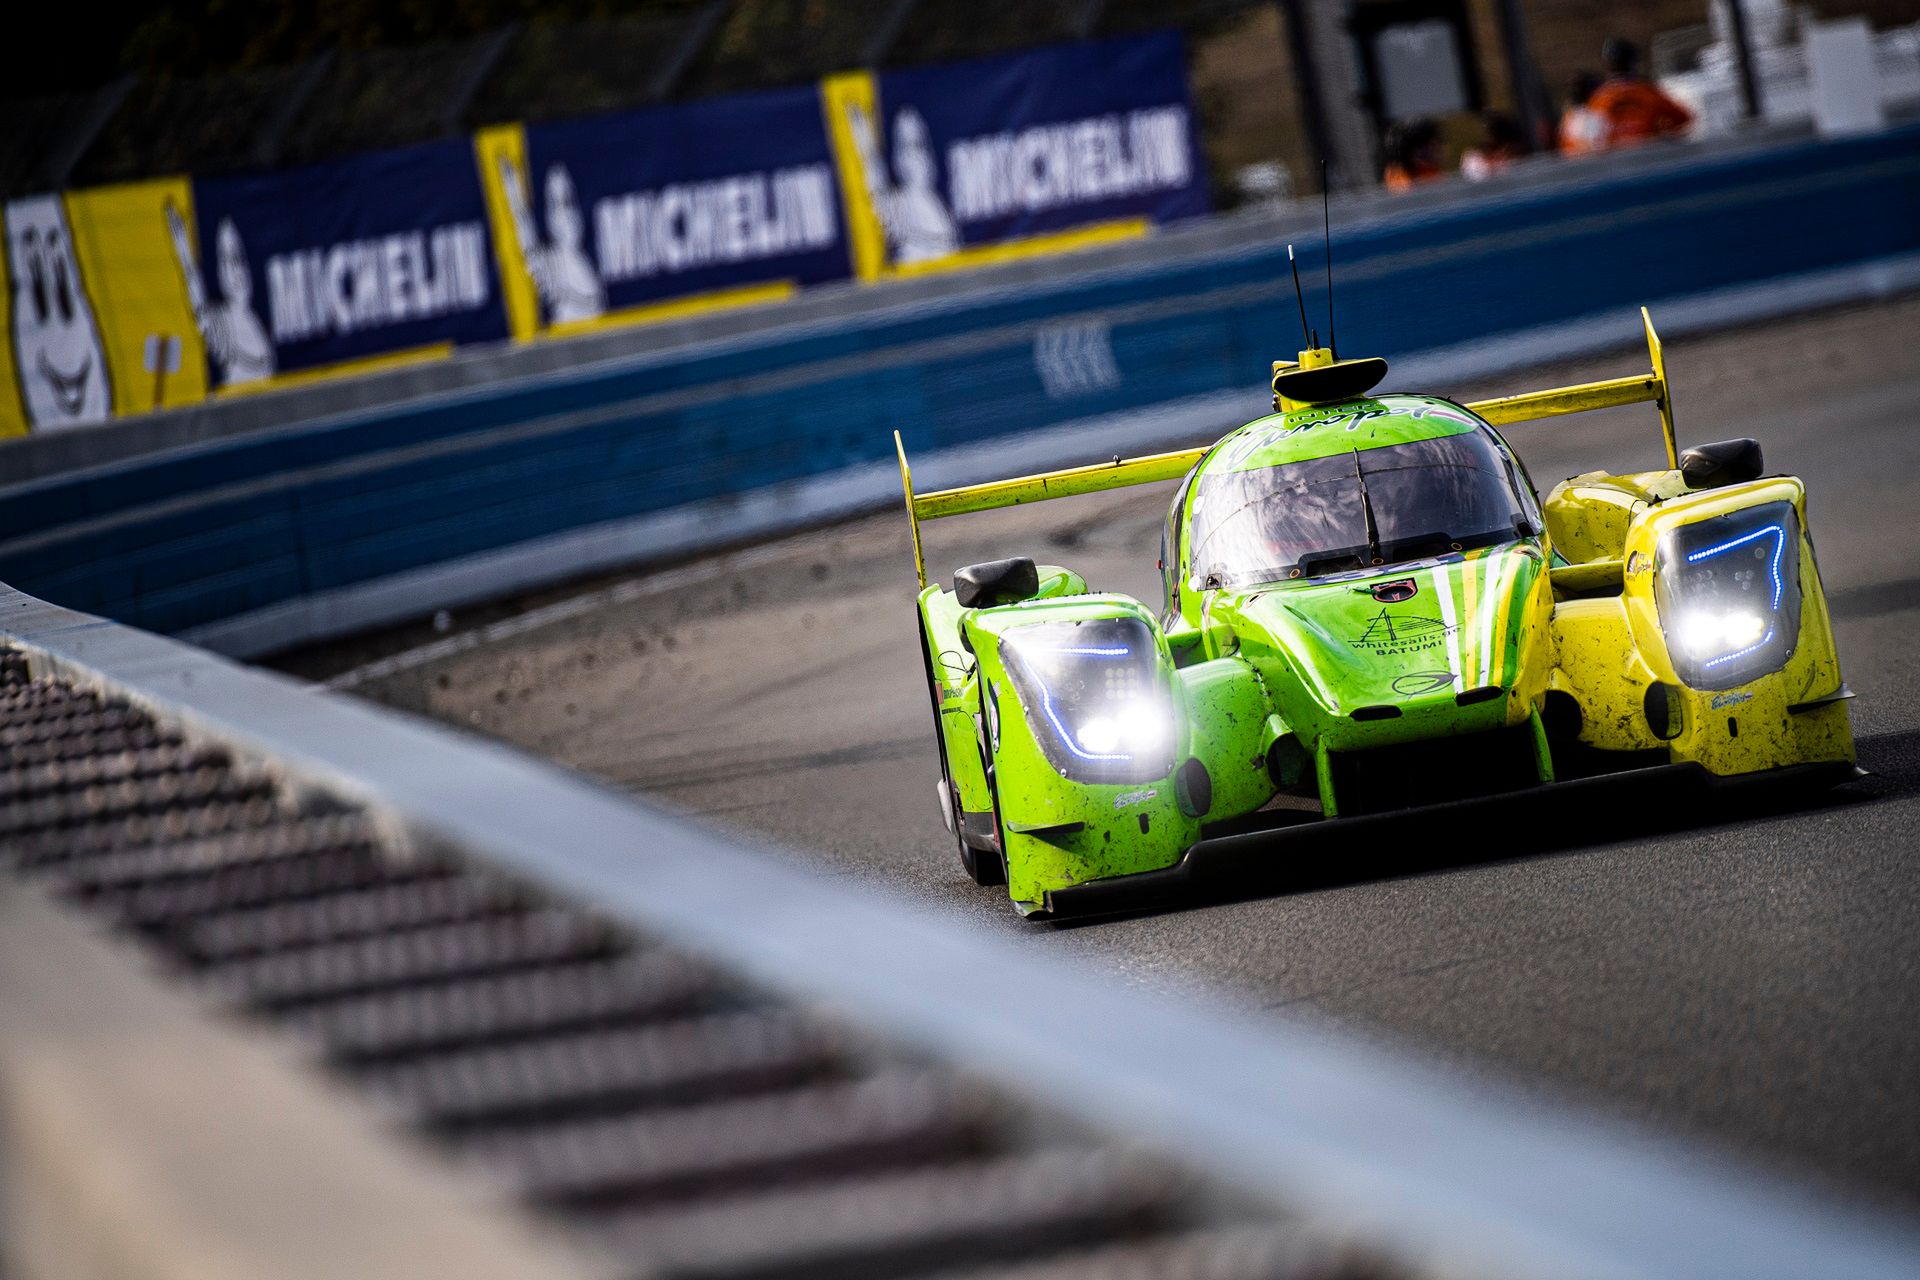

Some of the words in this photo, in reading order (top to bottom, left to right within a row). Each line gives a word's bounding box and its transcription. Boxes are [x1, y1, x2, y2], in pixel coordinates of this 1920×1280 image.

[594, 162, 837, 281] MICHELIN
[947, 105, 1194, 222] MICHELIN
[267, 221, 488, 342] MICHELIN
[1351, 627, 1461, 649] whitesails.ge
[1376, 640, 1443, 656] BATUMI
